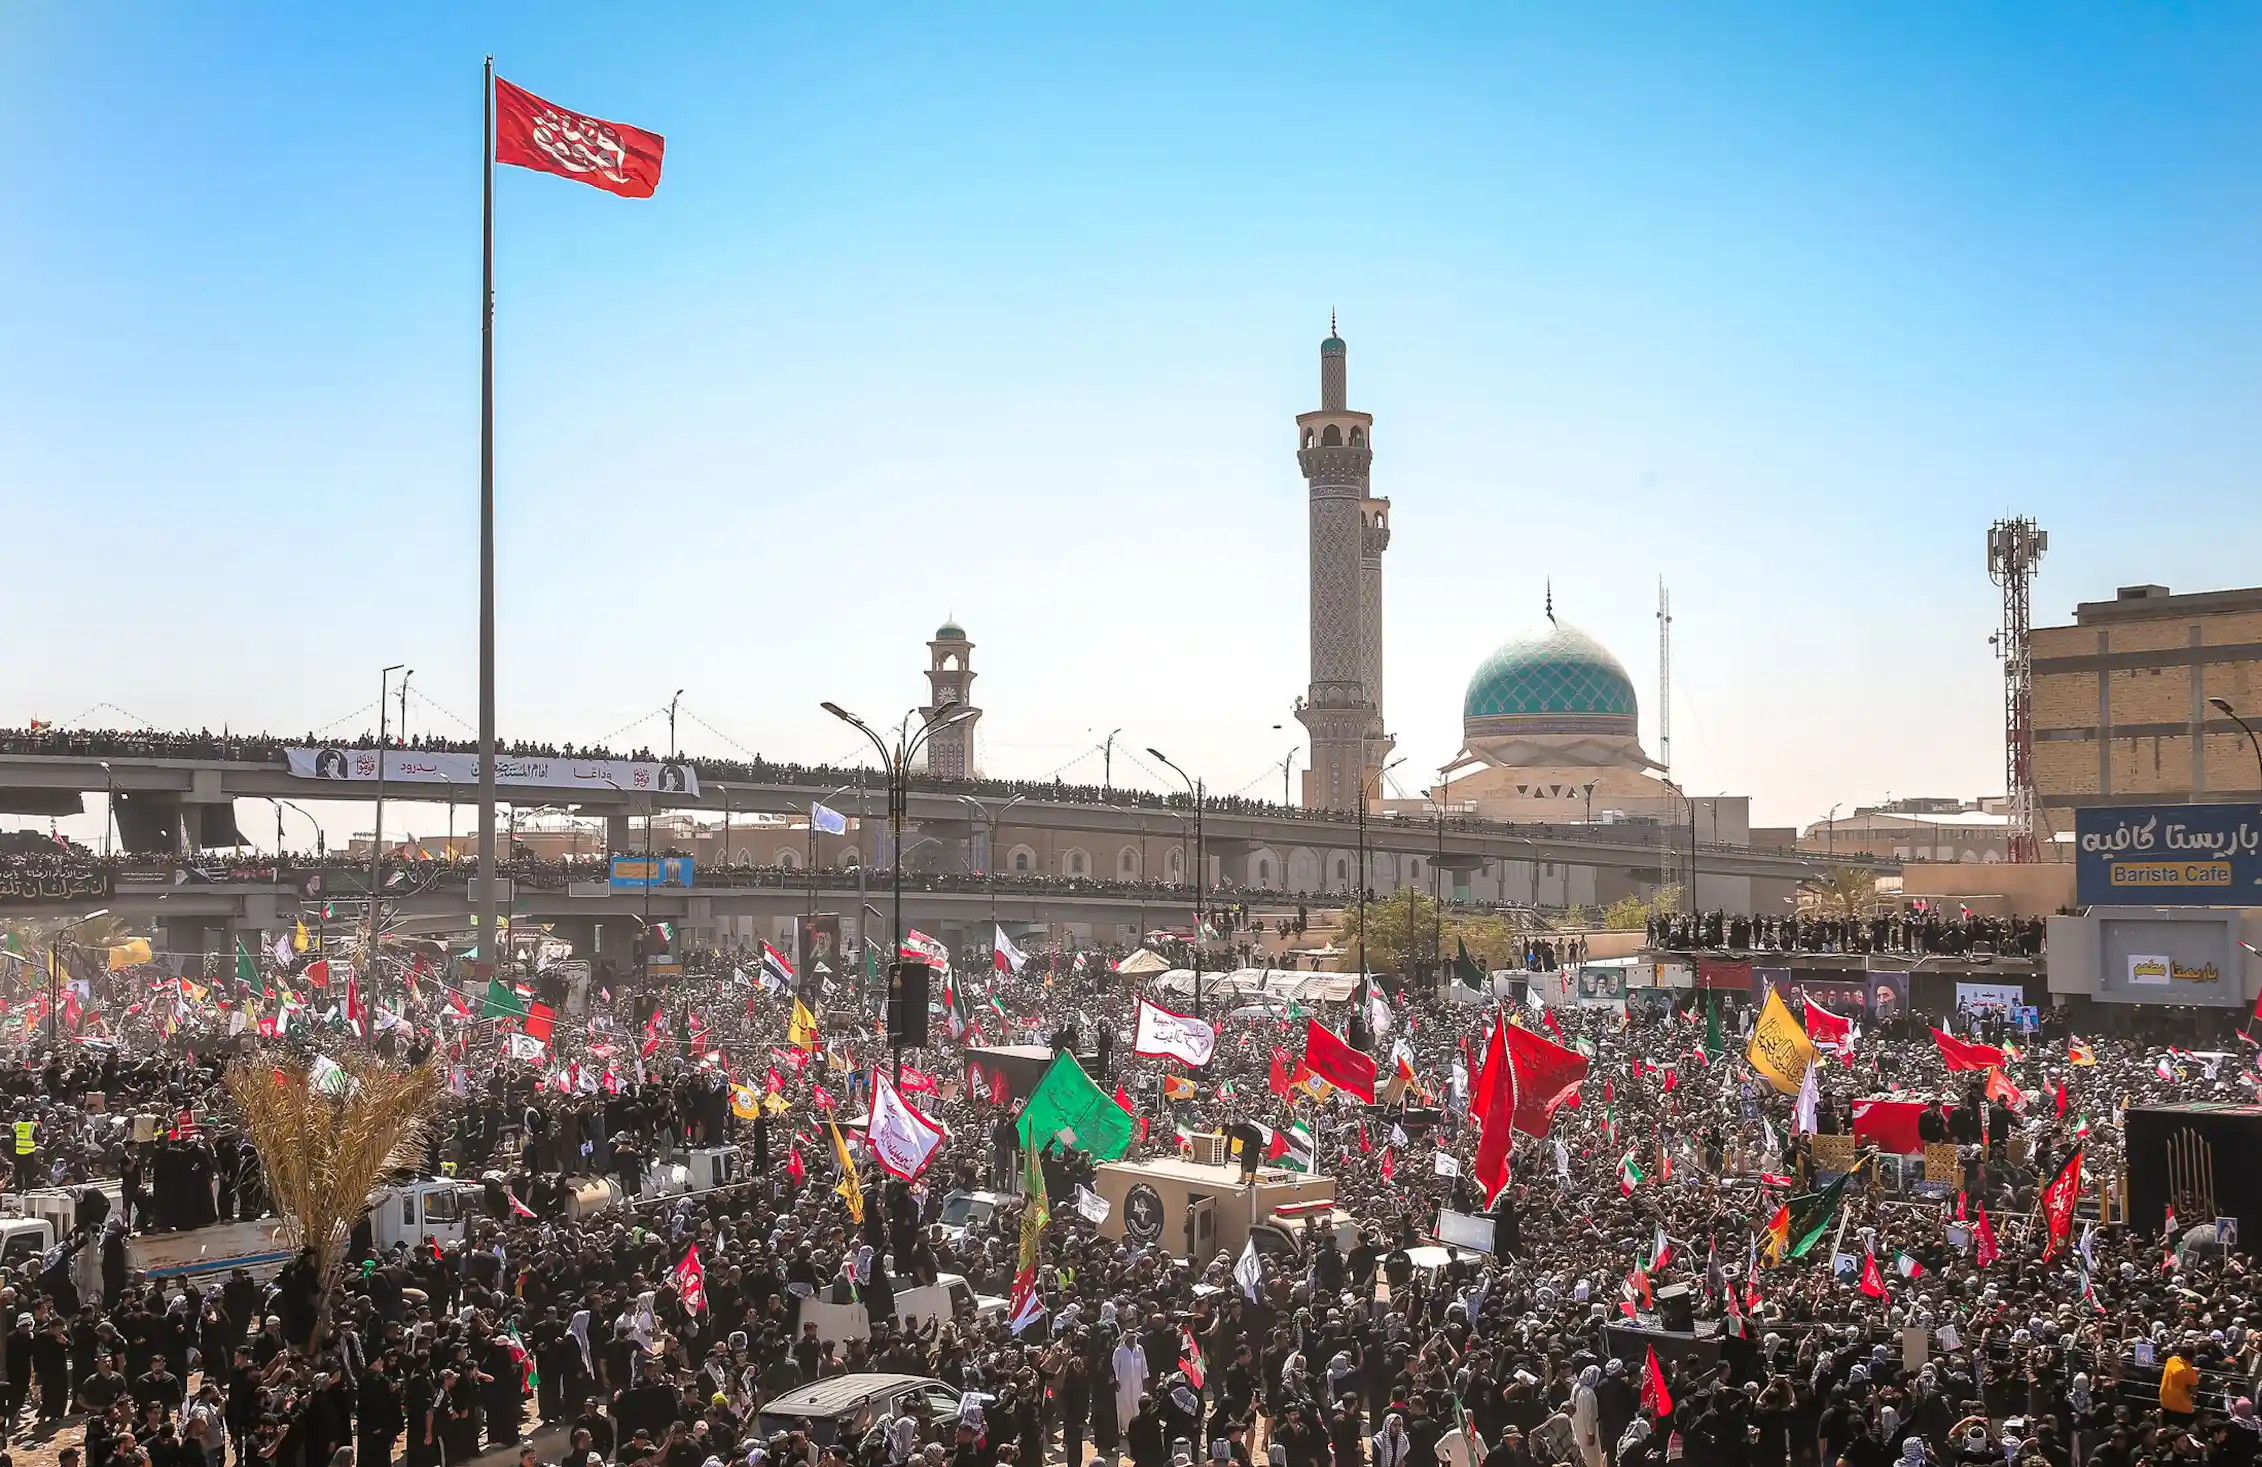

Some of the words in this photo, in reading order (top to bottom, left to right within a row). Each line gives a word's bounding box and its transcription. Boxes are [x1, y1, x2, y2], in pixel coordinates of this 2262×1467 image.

[2082, 815, 2157, 860] كافيه
[2165, 823, 2259, 859] باريستا
[2114, 865, 2179, 882] Barista
[2185, 865, 2229, 882] Cafe
